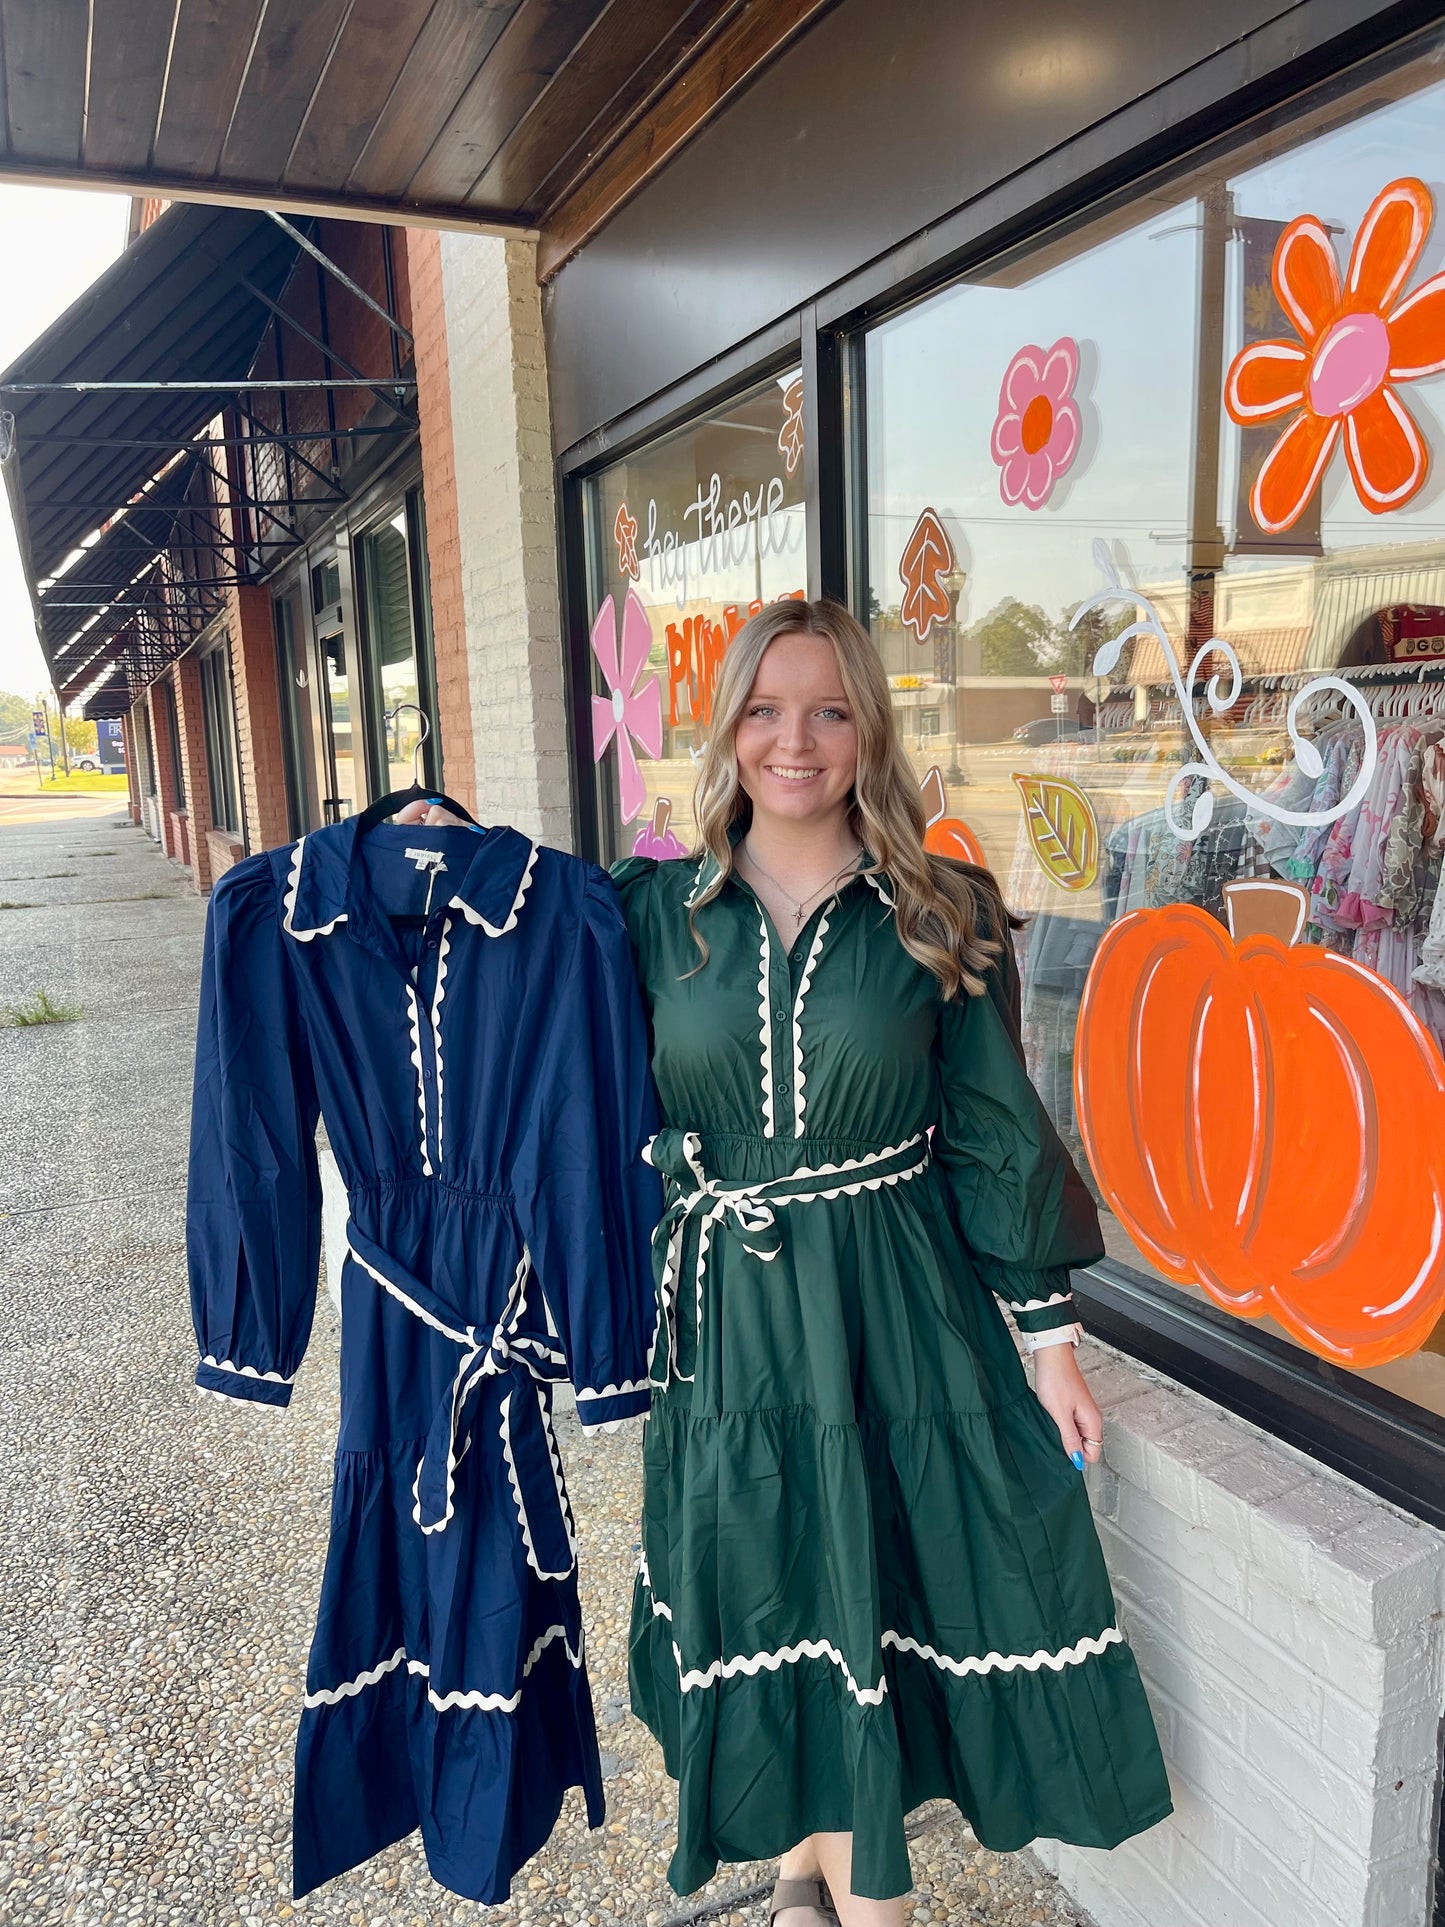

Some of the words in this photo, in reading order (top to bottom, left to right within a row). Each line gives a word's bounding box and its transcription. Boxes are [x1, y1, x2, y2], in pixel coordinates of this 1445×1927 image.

[643, 498, 687, 611] hey
[683, 472, 792, 575] there
[1417, 640, 1429, 651] G
